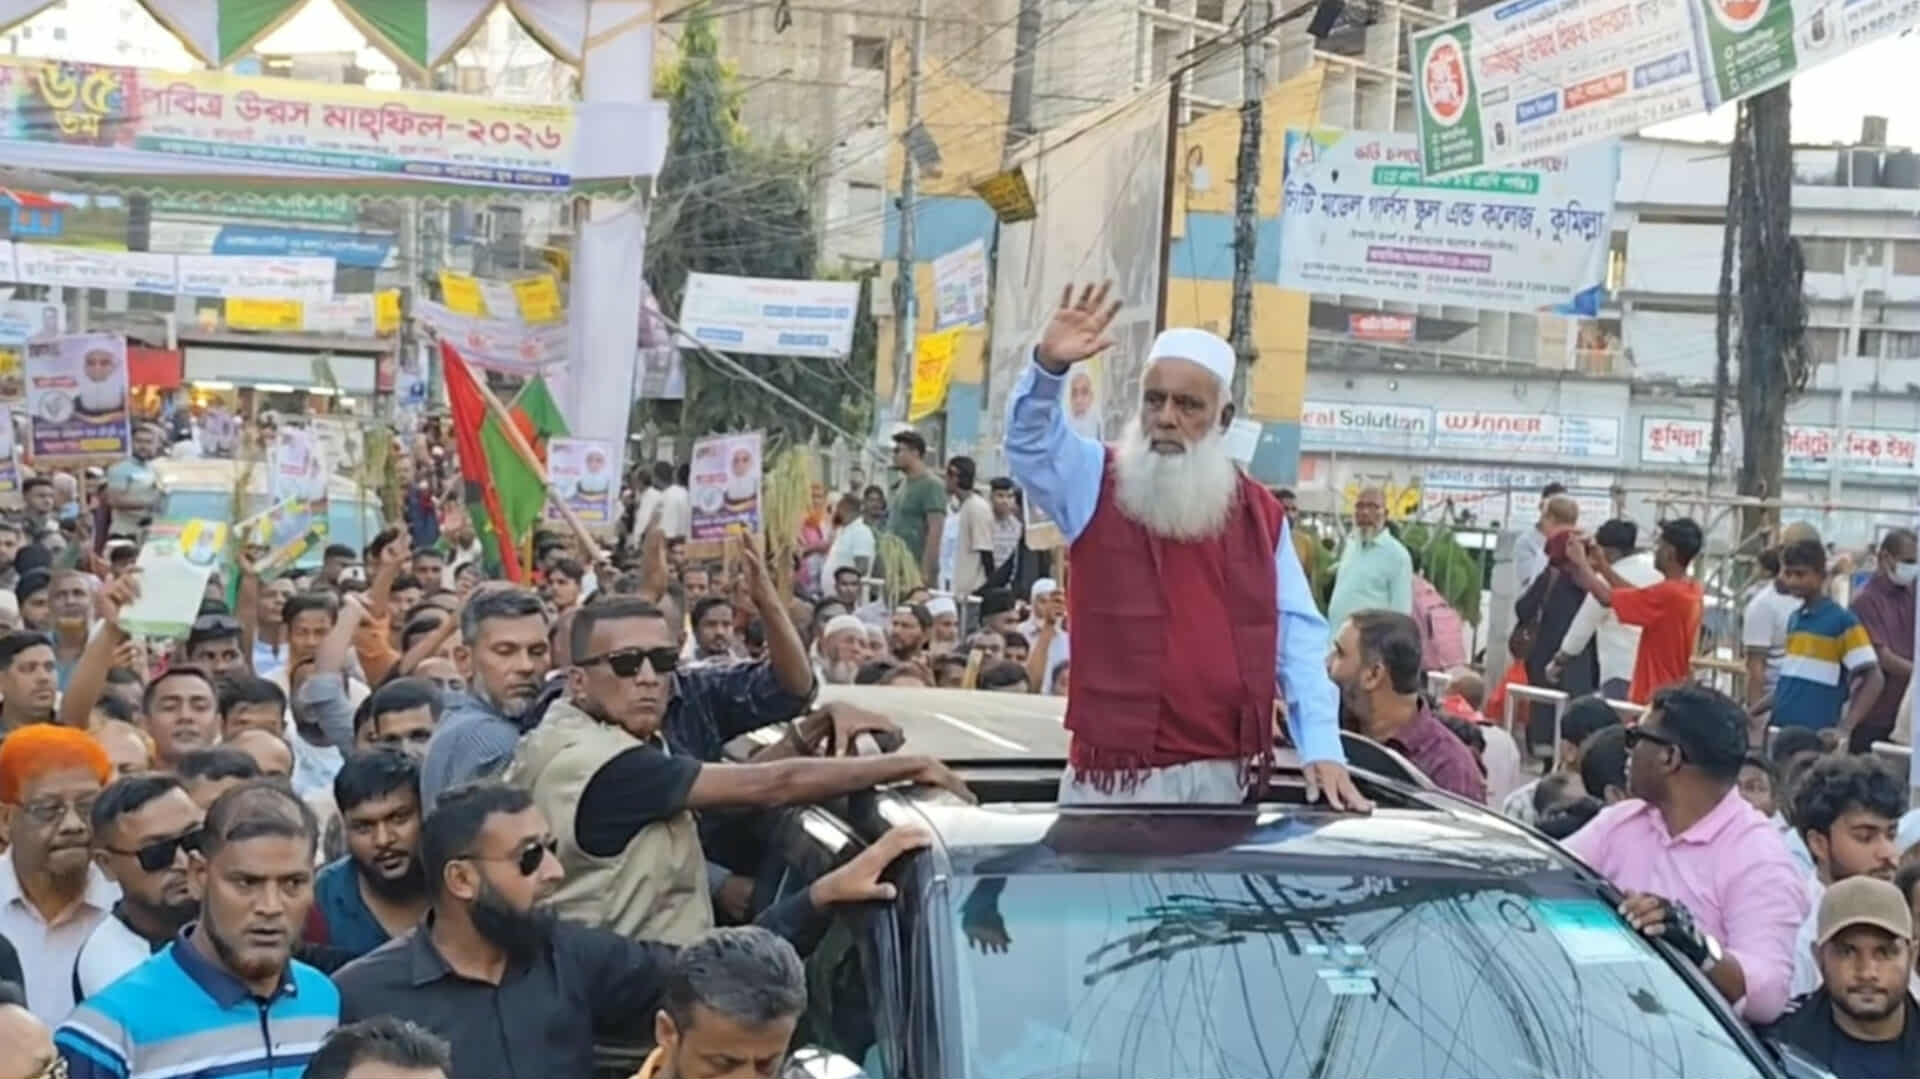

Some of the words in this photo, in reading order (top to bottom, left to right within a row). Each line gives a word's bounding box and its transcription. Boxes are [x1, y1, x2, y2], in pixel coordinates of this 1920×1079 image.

[143, 81, 225, 119] পবিত্র
[236, 89, 313, 127] উরস
[1321, 193, 1364, 222] মডেল
[1369, 187, 1409, 225] গার্লস
[1413, 198, 1443, 230] স্কুল
[1549, 199, 1606, 243] কুমিল্লা
[1339, 408, 1425, 431] Solution
